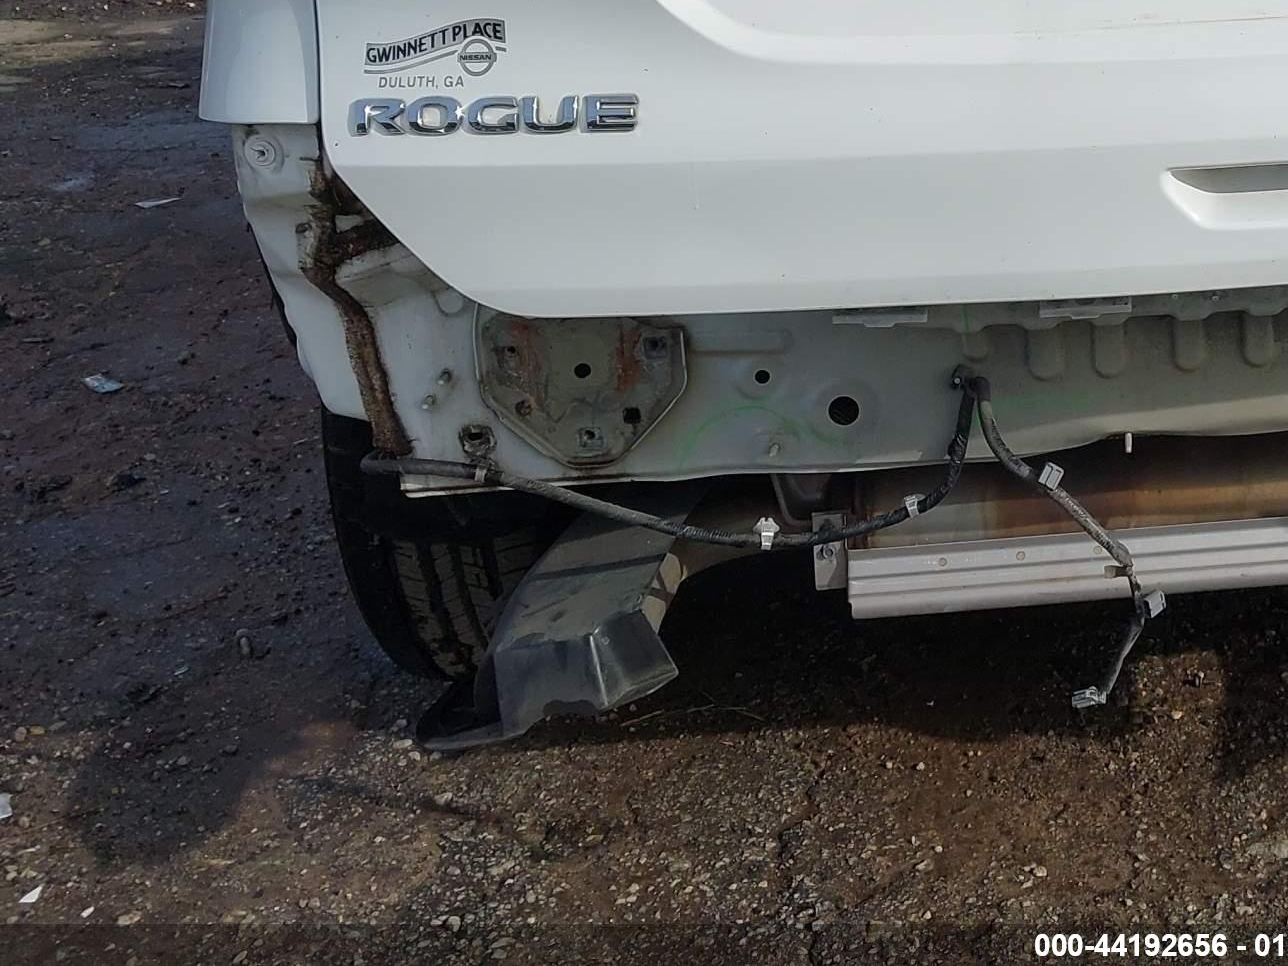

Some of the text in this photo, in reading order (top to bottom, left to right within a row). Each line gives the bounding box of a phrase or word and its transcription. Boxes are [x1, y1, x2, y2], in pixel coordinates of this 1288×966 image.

[366, 22, 503, 63] GWINNETT PLACE
[459, 53, 492, 61] NISSAN
[378, 75, 464, 89] DULUTH, GA
[350, 94, 639, 134] ROGUE
